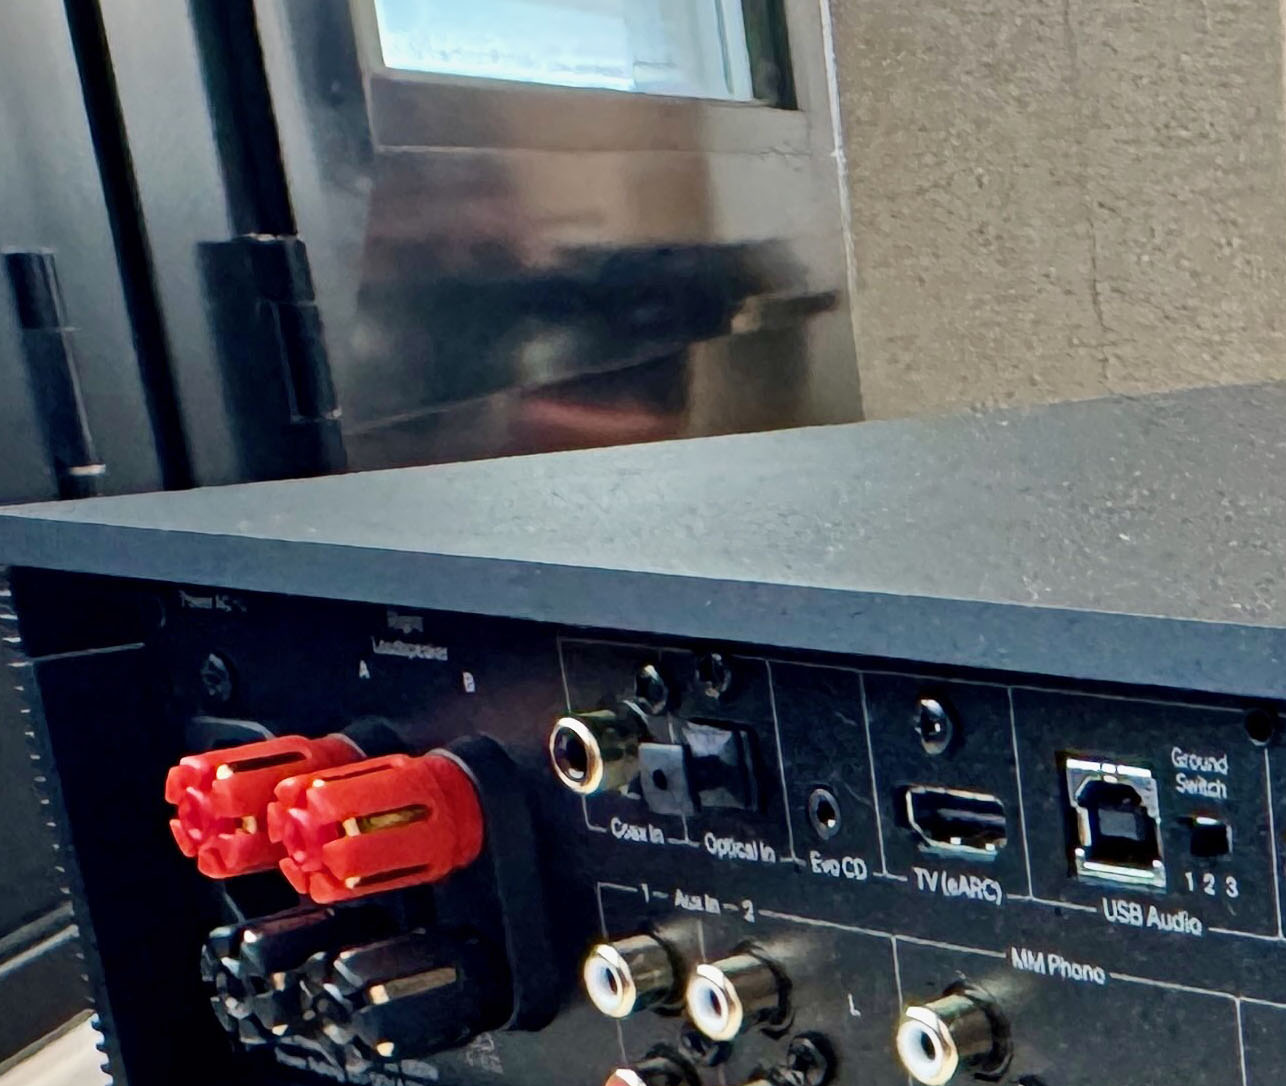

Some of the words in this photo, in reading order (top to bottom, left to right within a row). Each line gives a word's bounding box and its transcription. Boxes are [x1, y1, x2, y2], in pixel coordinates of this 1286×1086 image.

[359, 660, 370, 679] A
[1171, 747, 1229, 775] Ground
[1176, 772, 1228, 800] Switch
[704, 832, 759, 862] Optical
[759, 841, 776, 863] In
[810, 850, 840, 878] Evo
[842, 856, 868, 881] CD
[913, 867, 938, 892] TV
[941, 872, 1003, 905] (eARC)
[1185, 871, 1194, 892] 1
[1203, 872, 1216, 895] 2
[1225, 876, 1239, 898] 3
[1103, 898, 1145, 928] USB
[1146, 905, 1203, 937] Audio
[1010, 946, 1047, 976] MM
[1048, 953, 1106, 985] Phono
[848, 993, 862, 1017] L
